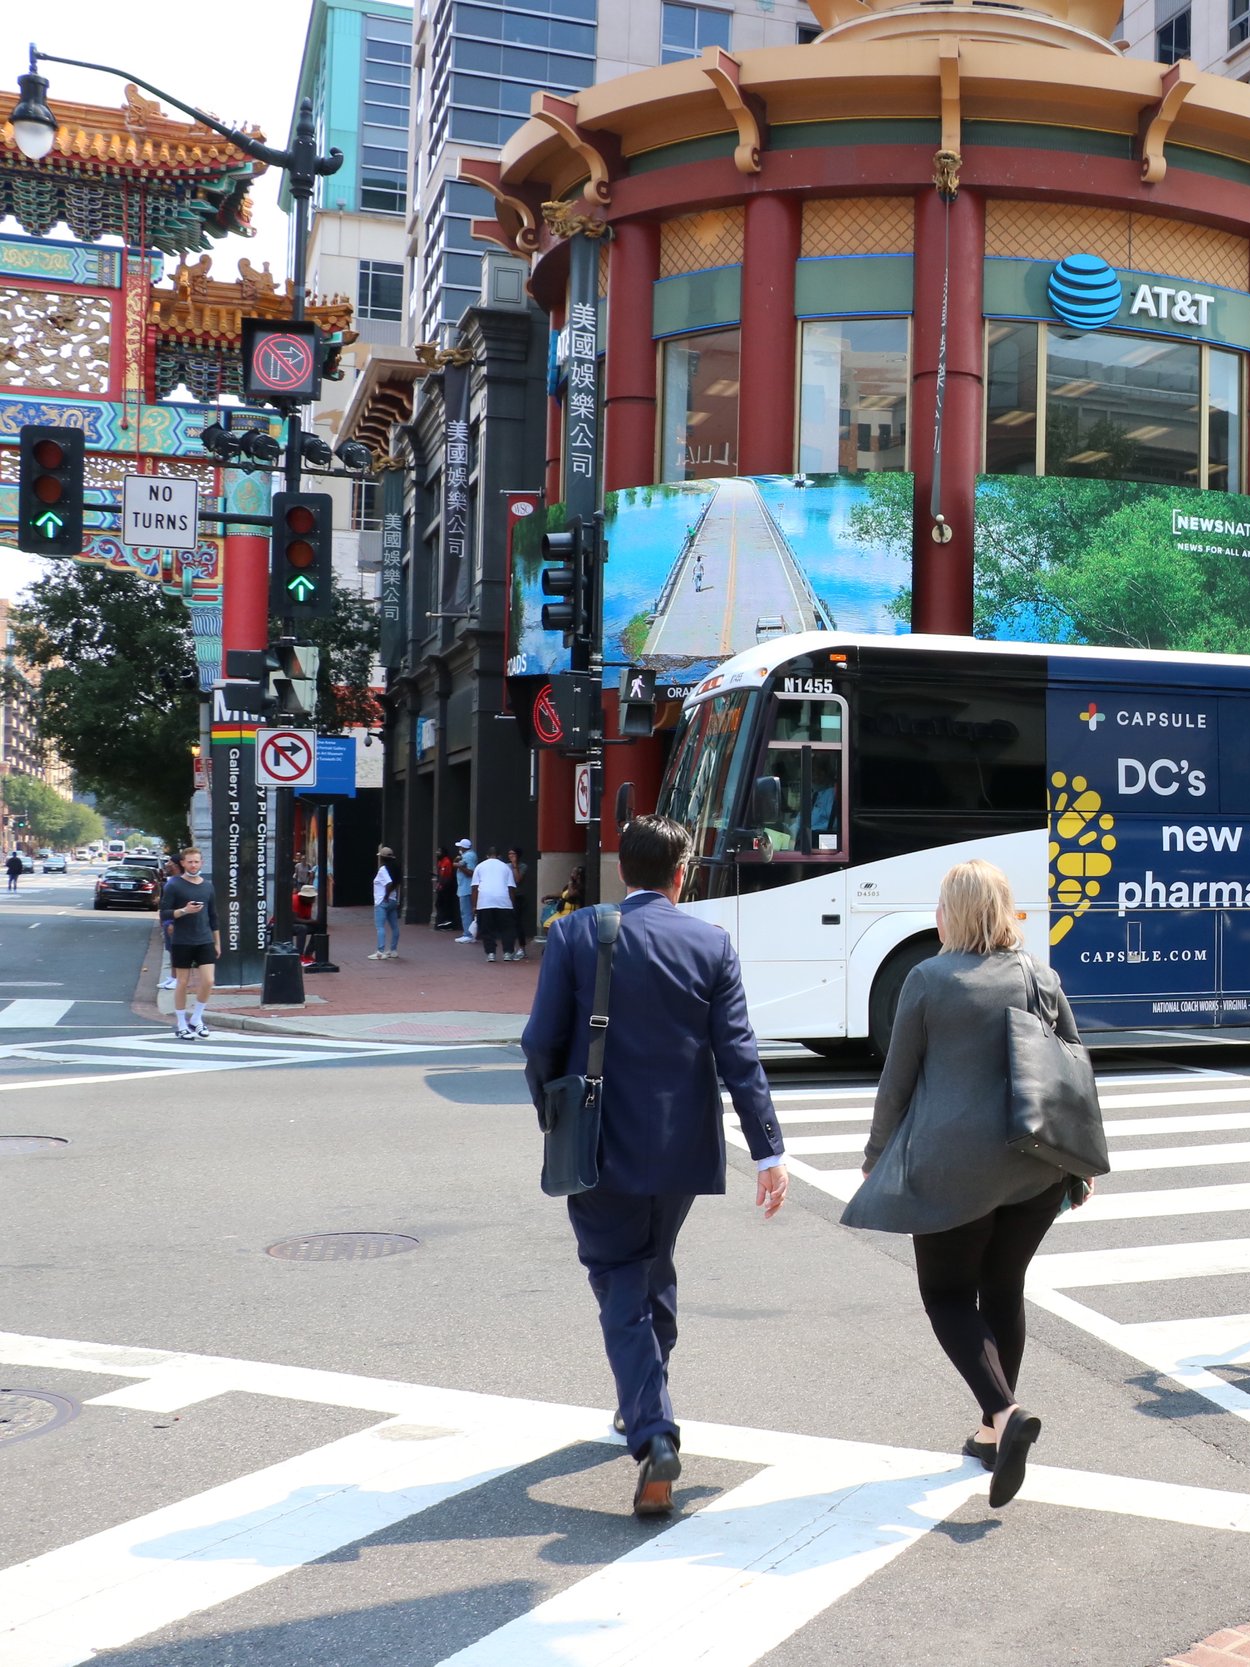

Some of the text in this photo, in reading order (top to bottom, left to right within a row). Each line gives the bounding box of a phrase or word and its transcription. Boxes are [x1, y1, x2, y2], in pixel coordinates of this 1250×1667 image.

[1130, 284, 1215, 326] AT&T
[570, 302, 597, 478] 美國娛樂公司
[149, 485, 173, 502] NO
[447, 420, 469, 558] 美國娛樂公司
[132, 511, 189, 531] TURNS
[1177, 543, 1203, 553] NEWS
[1206, 545, 1223, 554] FOR
[1225, 548, 1239, 557] ALL
[784, 677, 833, 693] N1455
[1116, 710, 1207, 729] CAPSULE
[229, 748, 240, 798] Gallery
[1117, 757, 1207, 797] DC's
[1162, 824, 1243, 852] new
[229, 901, 240, 951] Station
[257, 900, 267, 950] Station
[1152, 1001, 1180, 1014] NATIONAL
[1180, 1001, 1199, 1013] COACH
[1199, 1000, 1219, 1012] WORKS
[1222, 999, 1248, 1012] VIRGINIA
